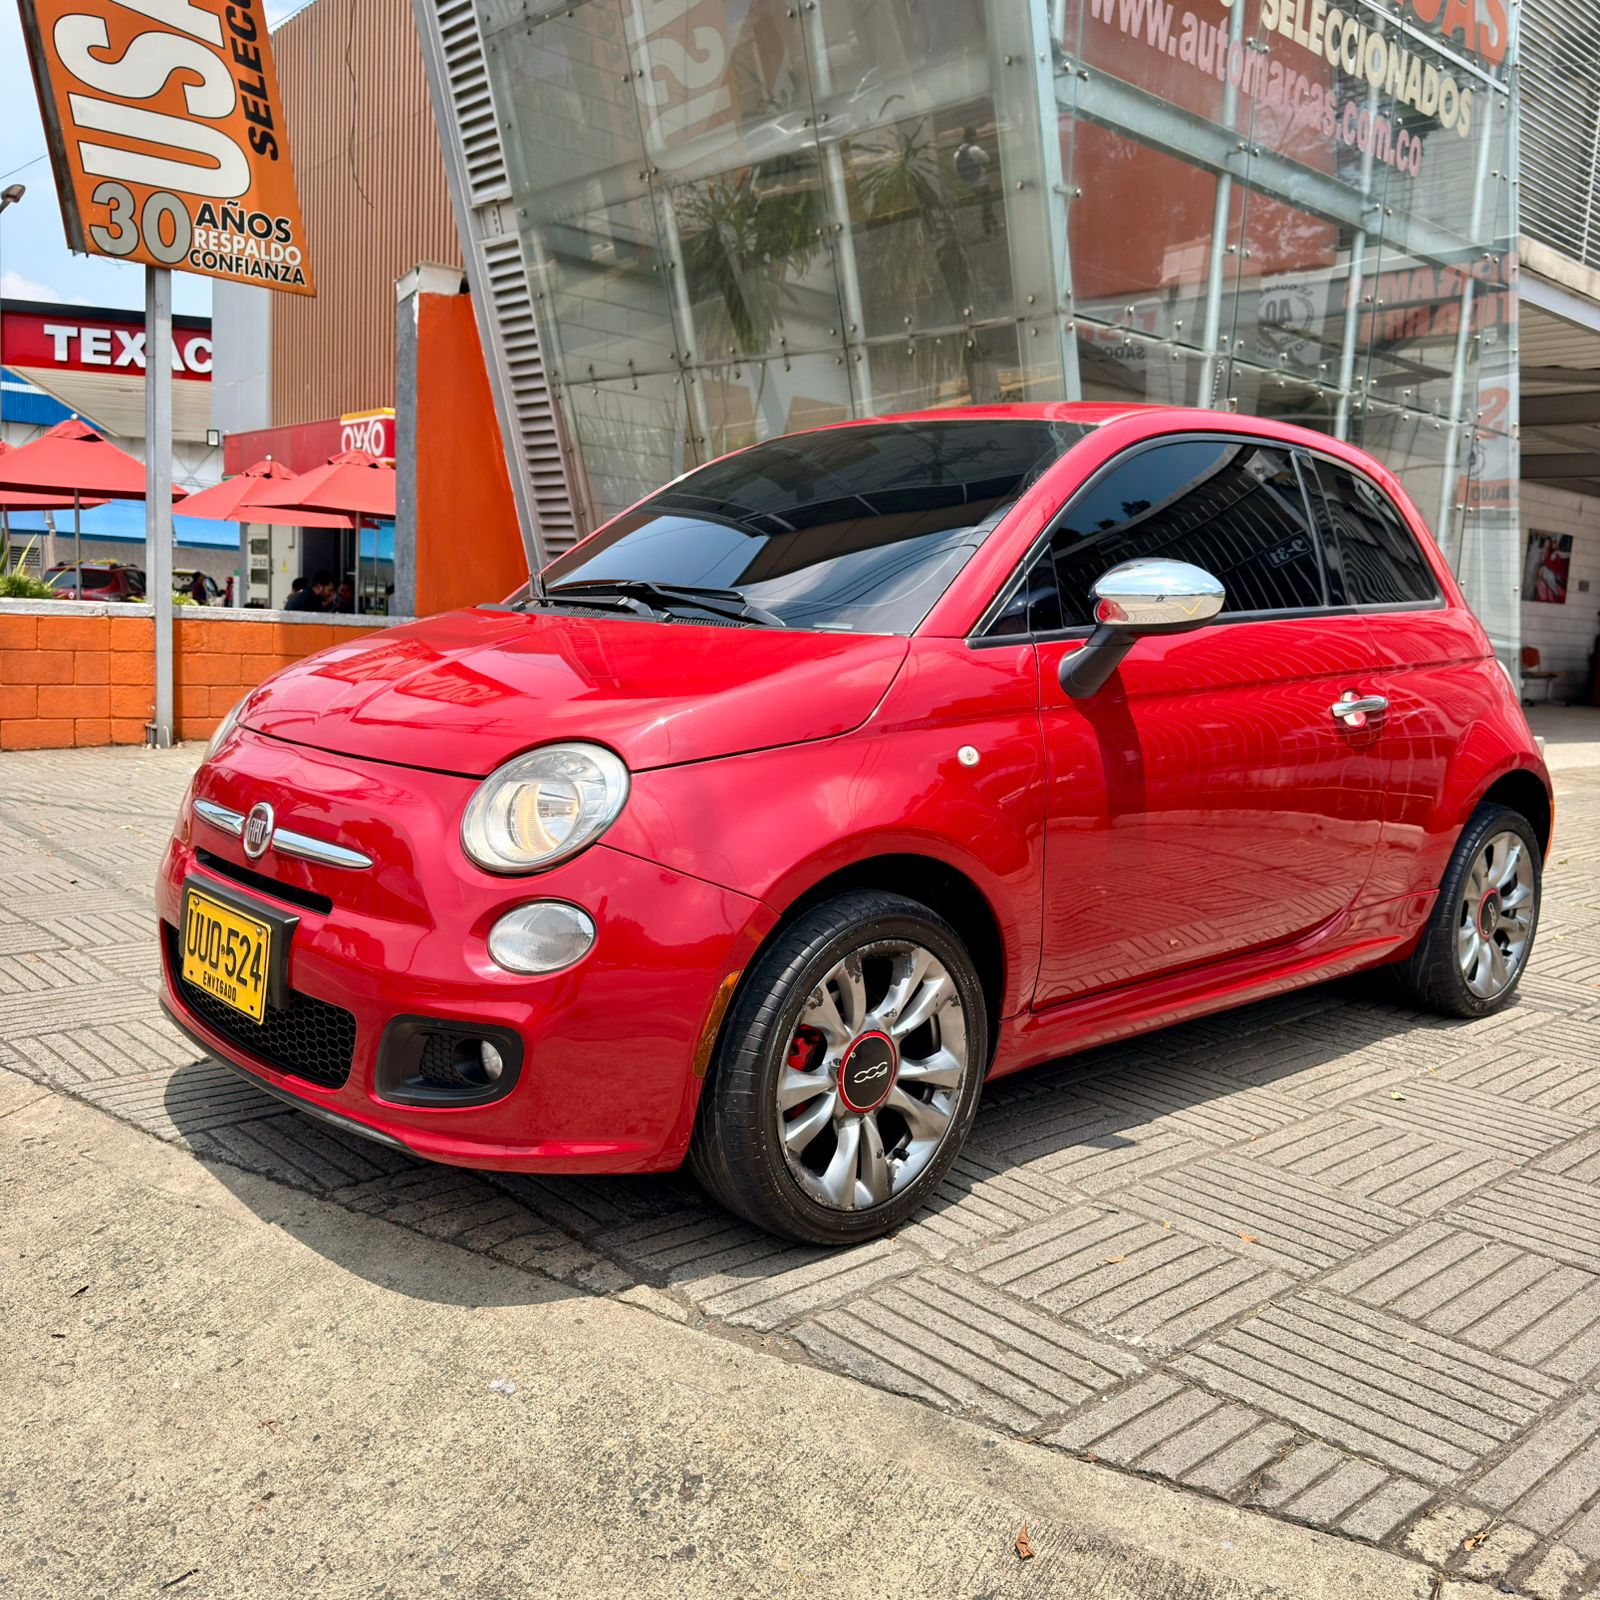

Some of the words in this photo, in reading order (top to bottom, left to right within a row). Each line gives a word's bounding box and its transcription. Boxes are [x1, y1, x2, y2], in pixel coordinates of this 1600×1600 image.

[225, 0, 278, 161] SELEC
[89, 182, 193, 264] 30
[194, 200, 292, 243] AÑOS
[194, 228, 302, 266] RESPALDO
[189, 249, 305, 286] CONFIANZA
[44, 324, 212, 374] TEXC
[247, 817, 267, 845] FIAT
[203, 970, 237, 1002] ENVIGADO
